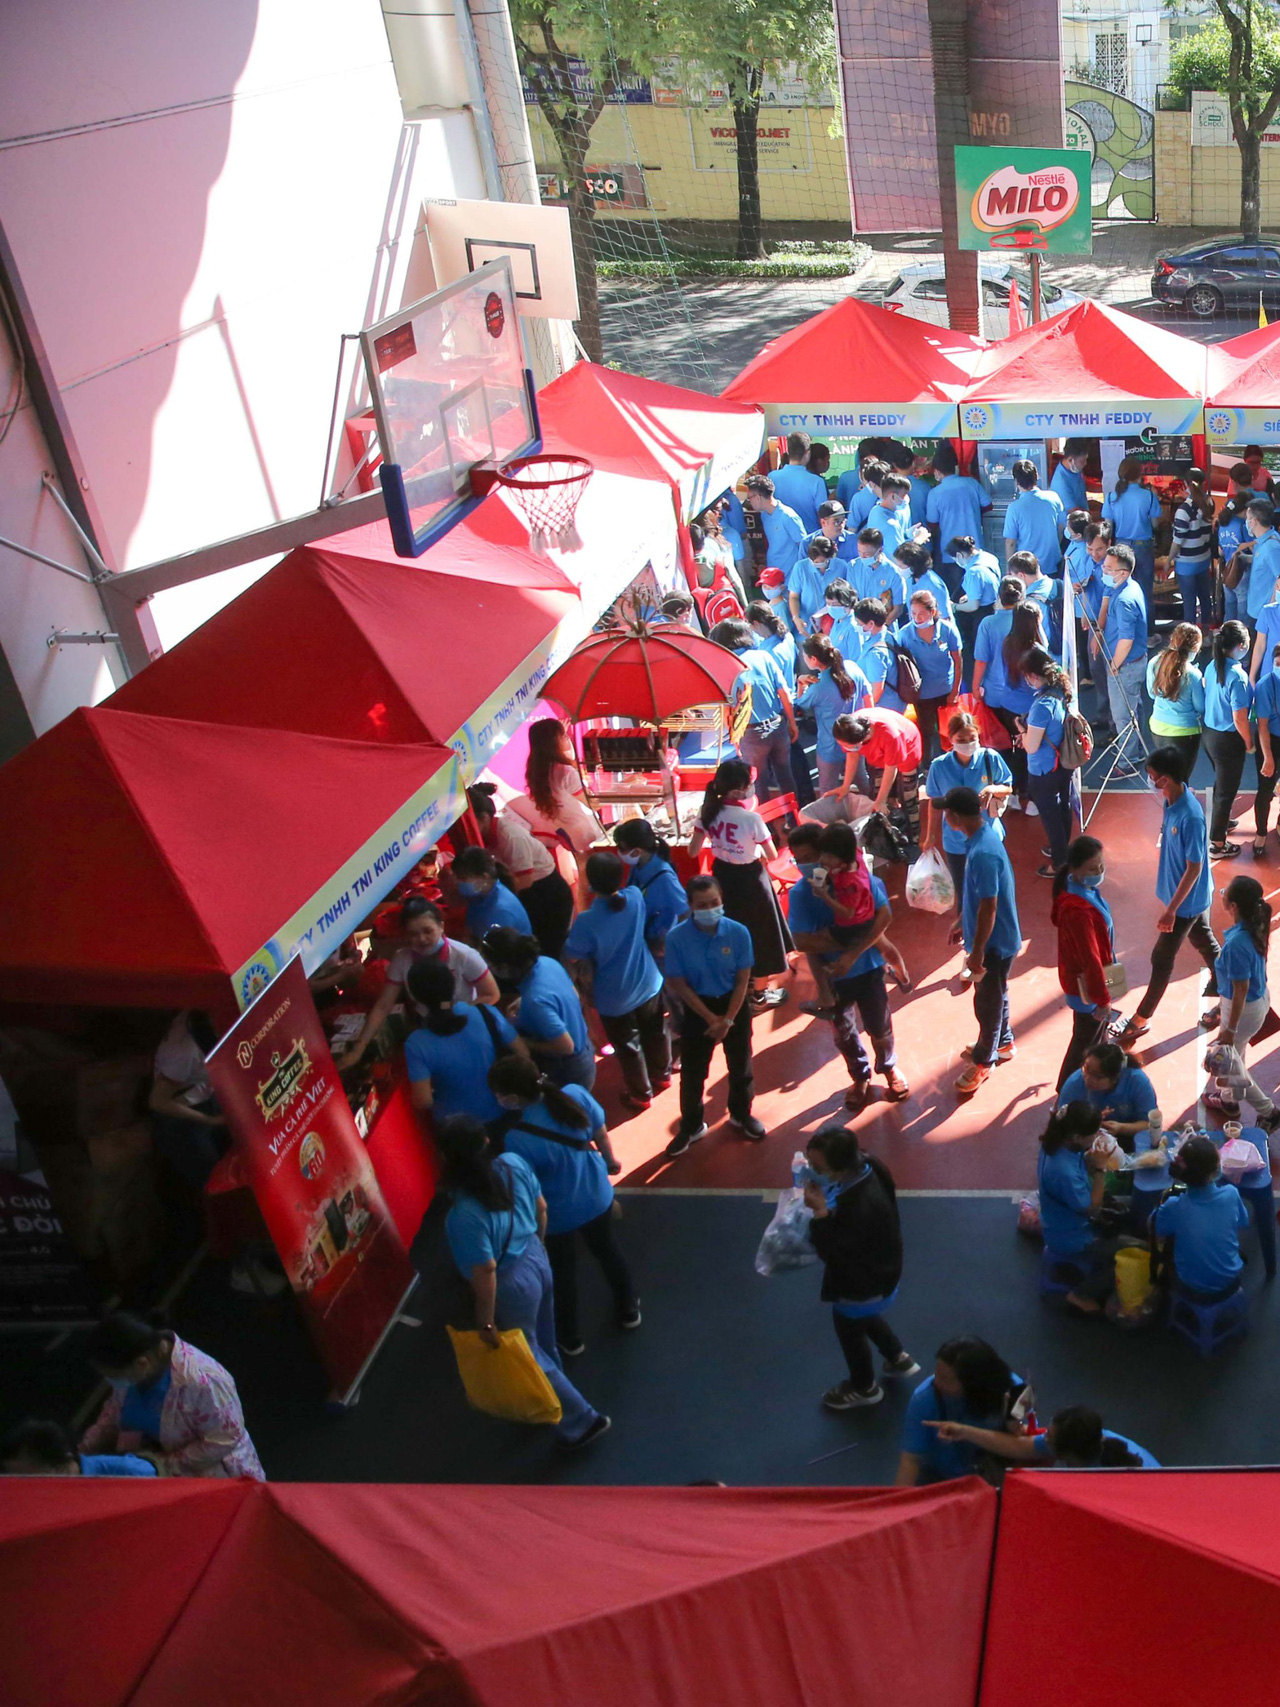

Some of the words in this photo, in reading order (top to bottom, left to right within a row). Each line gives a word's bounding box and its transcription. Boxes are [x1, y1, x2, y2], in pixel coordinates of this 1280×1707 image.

[987, 186, 1068, 216] MILO
[779, 414, 808, 426] CTY
[813, 414, 854, 426] TNHH
[859, 414, 906, 426] FEDDY
[1024, 414, 1054, 426] CTY
[1059, 413, 1100, 425] TNHH
[1105, 412, 1152, 424] FEDDY
[477, 722, 493, 747] CTY
[494, 698, 515, 728] TNHH
[515, 684, 529, 704] TNI
[528, 664, 547, 688] KING
[316, 891, 351, 934] TNHH
[351, 870, 373, 897] TNI
[374, 841, 401, 877] KING
[402, 799, 441, 847] COFFEE
[251, 997, 291, 1049] CORPORATION
[266, 1086, 282, 1106] KING
[281, 1058, 303, 1089] COFFEE
